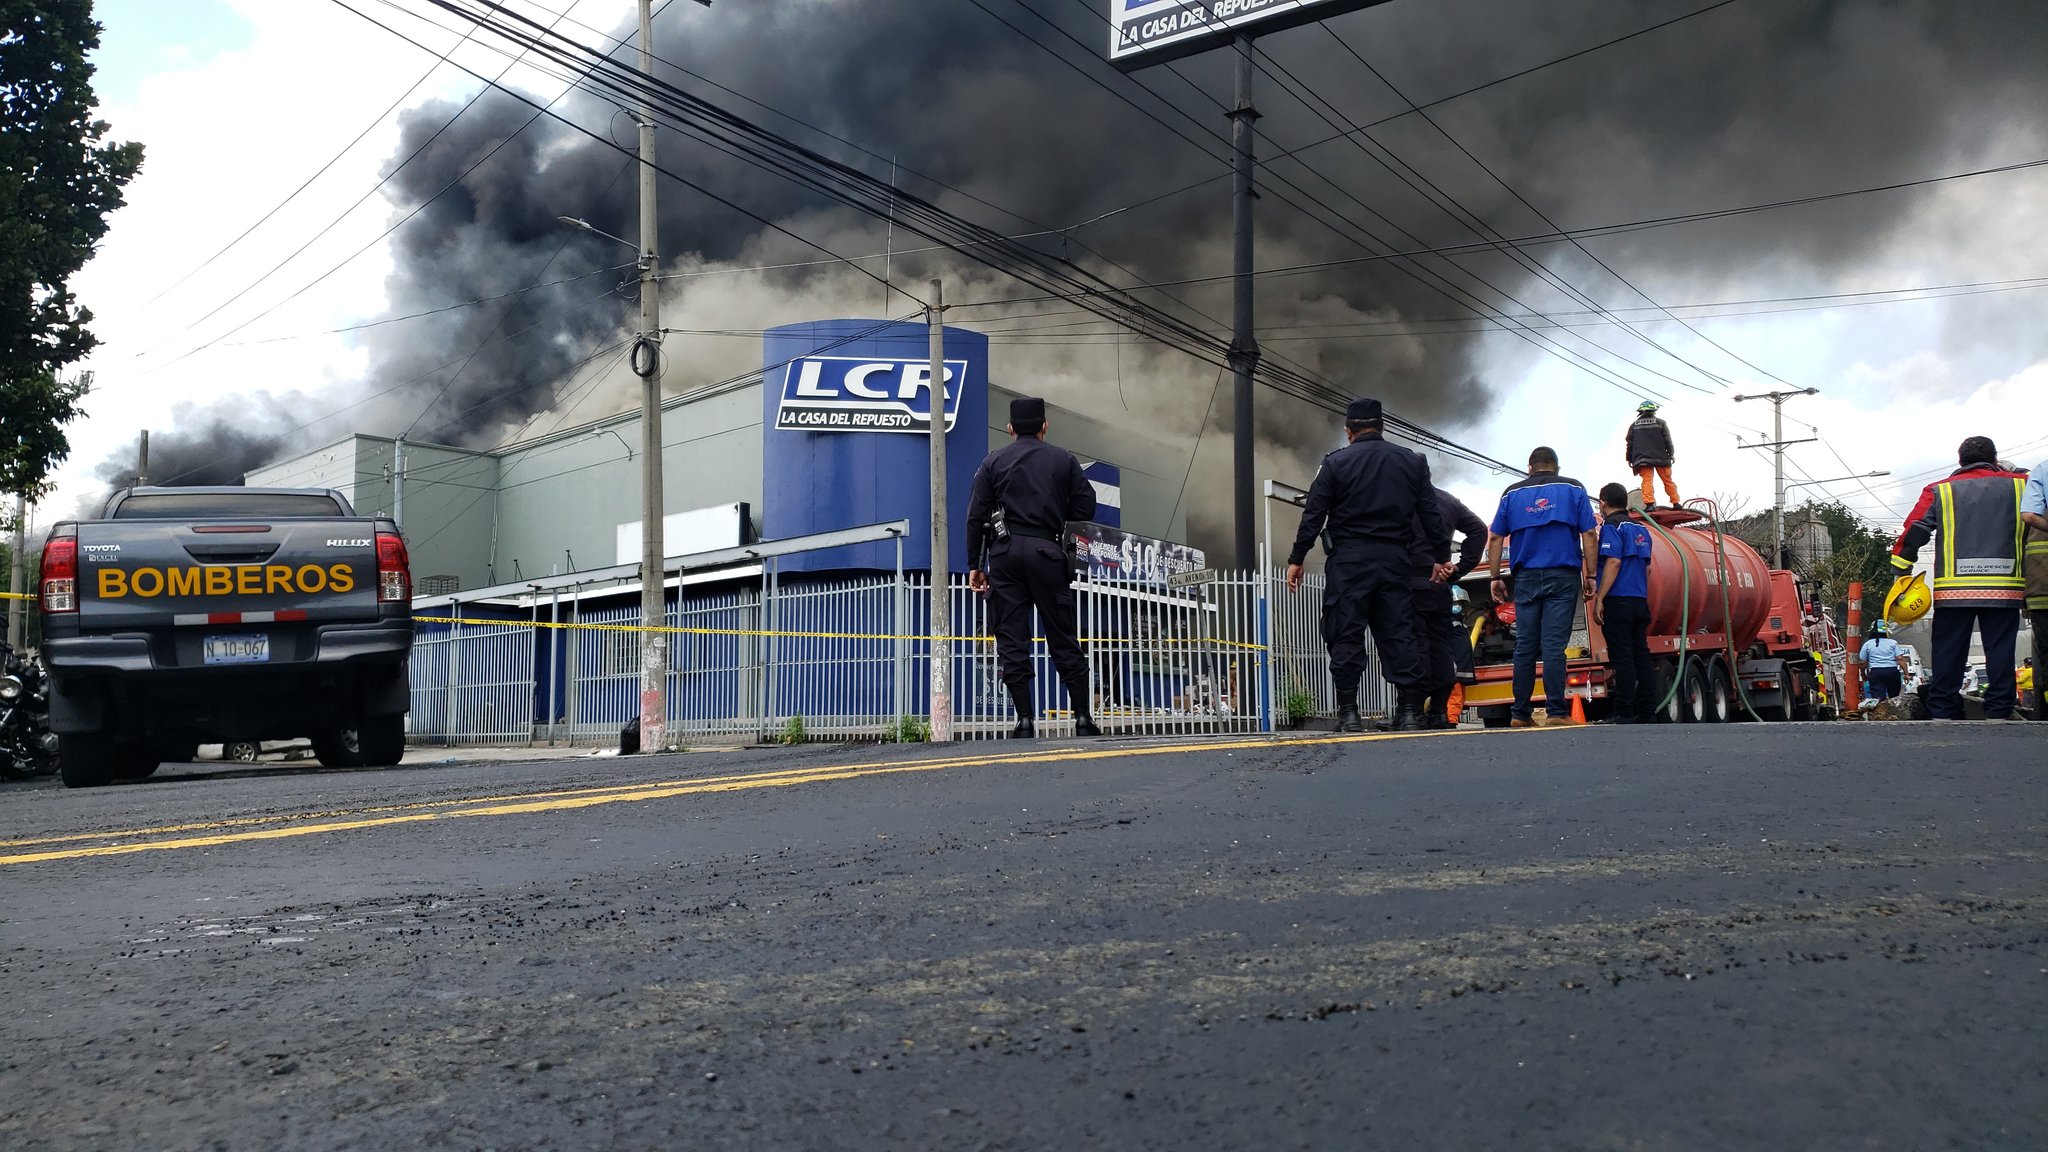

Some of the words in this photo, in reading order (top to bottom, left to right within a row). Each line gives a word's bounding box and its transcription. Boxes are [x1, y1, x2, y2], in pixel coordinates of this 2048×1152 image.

[1120, 26, 1138, 46] LA
[1141, 14, 1178, 39] CASA
[1180, 6, 1207, 29] DEL
[796, 361, 954, 399] LCR
[781, 412, 796, 424] LA
[798, 412, 827, 425] CASA
[829, 413, 851, 426] DEL
[852, 413, 911, 427] REPUESTO
[83, 544, 121, 552] TOYOTA
[326, 539, 371, 547] HILUX
[1122, 537, 1155, 578] $10
[97, 563, 355, 599] BOMBEROS
[1909, 598, 1924, 611] 673
[206, 641, 215, 657] N
